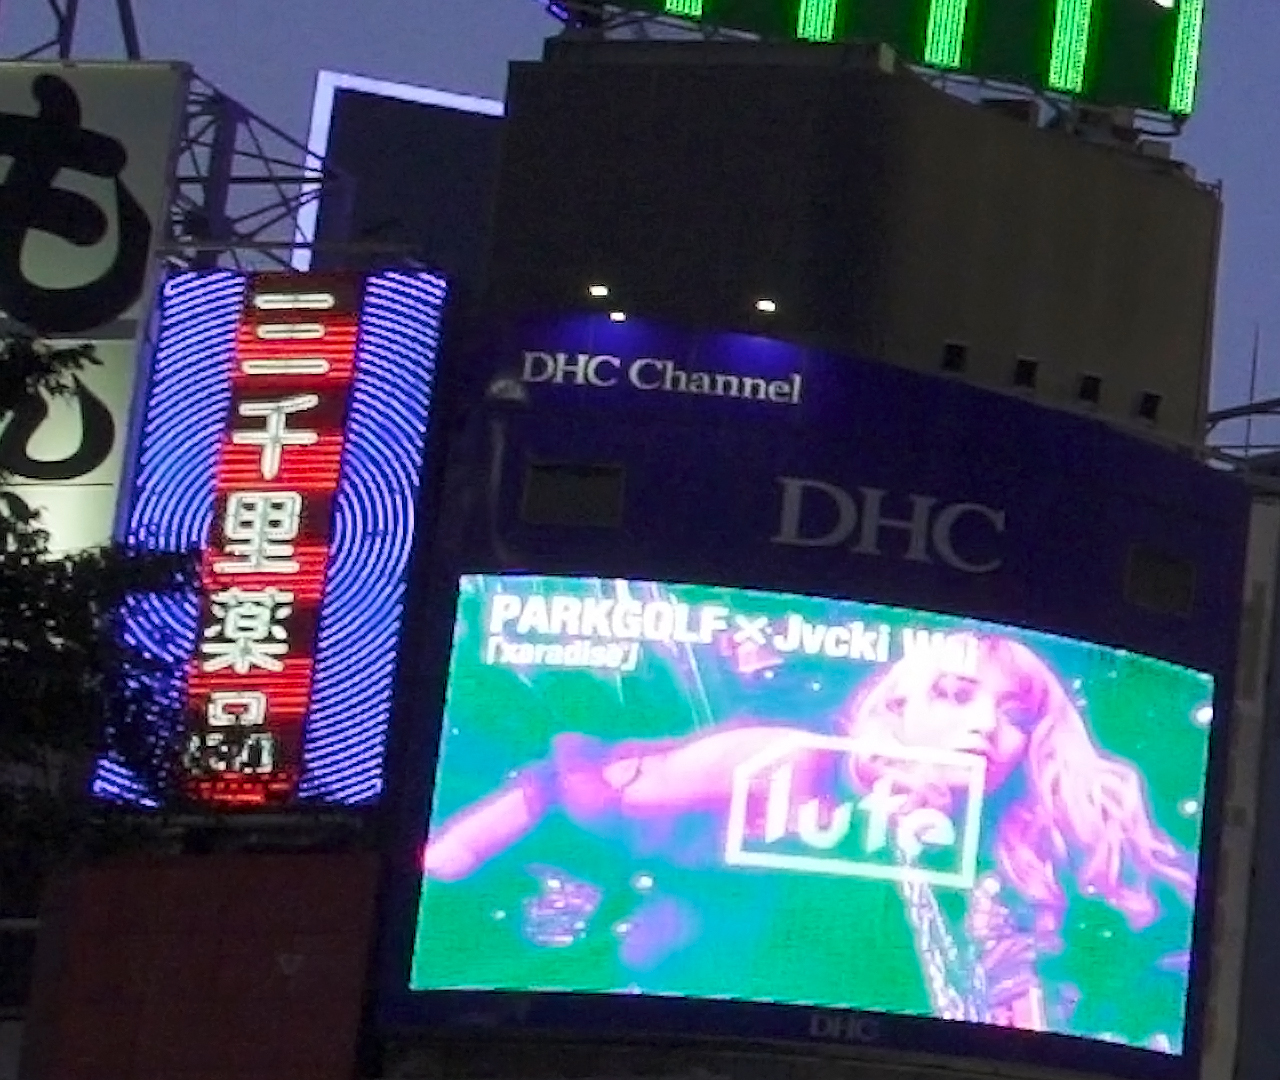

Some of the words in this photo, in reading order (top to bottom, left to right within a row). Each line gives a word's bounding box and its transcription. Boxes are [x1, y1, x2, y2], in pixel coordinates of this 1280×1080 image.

[522, 351, 621, 388] DHC
[628, 357, 802, 405] Channel
[771, 475, 1006, 574] DHC
[489, 595, 730, 645] PARKGOLF
[773, 613, 891, 662] Jvcki
[810, 1013, 880, 1040] DHC
